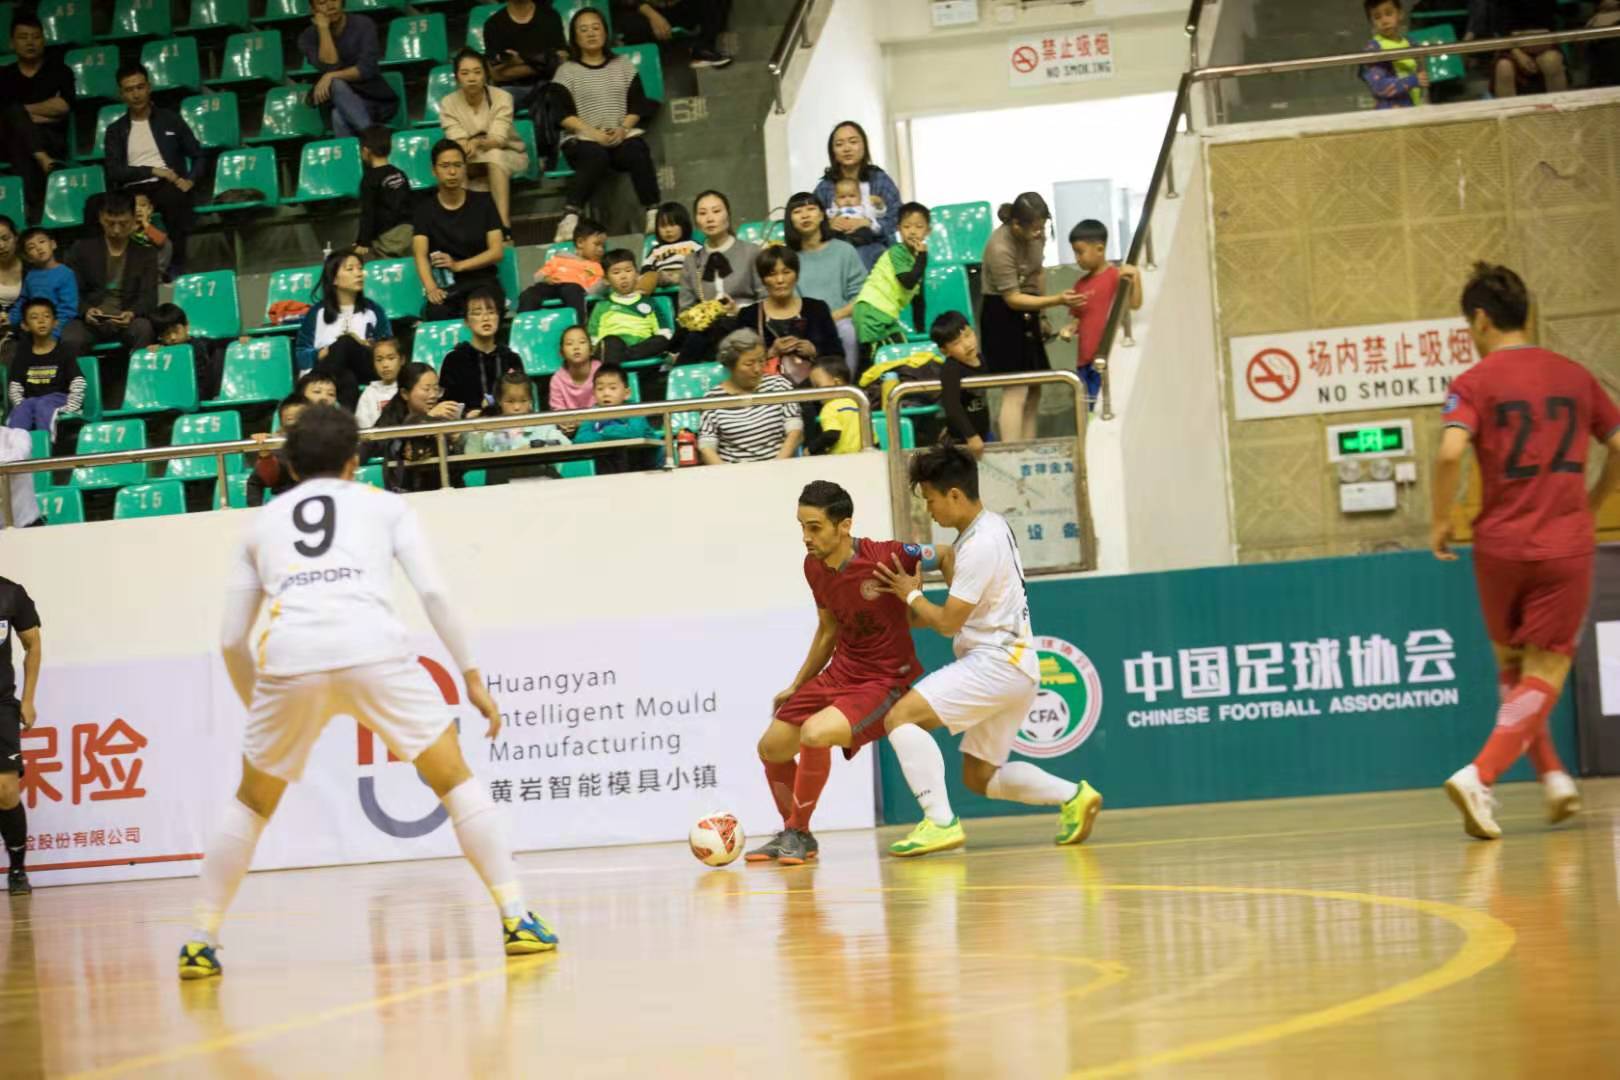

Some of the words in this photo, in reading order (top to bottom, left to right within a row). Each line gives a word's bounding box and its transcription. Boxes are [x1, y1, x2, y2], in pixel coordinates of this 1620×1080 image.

[1041, 32, 1110, 61] 禁止吸烟
[1046, 66, 1060, 78] NO
[1063, 61, 1111, 76] SMOKING
[1307, 328, 1473, 378] 场内禁止吸烟
[1318, 386, 1347, 404] NO
[1359, 374, 1452, 399] SMOKIN
[1496, 397, 1584, 479] 22
[292, 495, 336, 558] 9
[487, 669, 616, 695] Huangyan
[1123, 628, 1456, 703] 中国足球协会
[498, 700, 624, 728] ntelligent
[636, 690, 717, 717] Mould
[1028, 709, 1060, 724] CFA
[1127, 706, 1210, 728] CHINESE
[1219, 698, 1321, 721] FOOTBALL
[1329, 688, 1459, 714] ASSOCIATION
[489, 731, 681, 764] Manufacturing
[489, 764, 718, 804] 黄岩智能模具小镇
